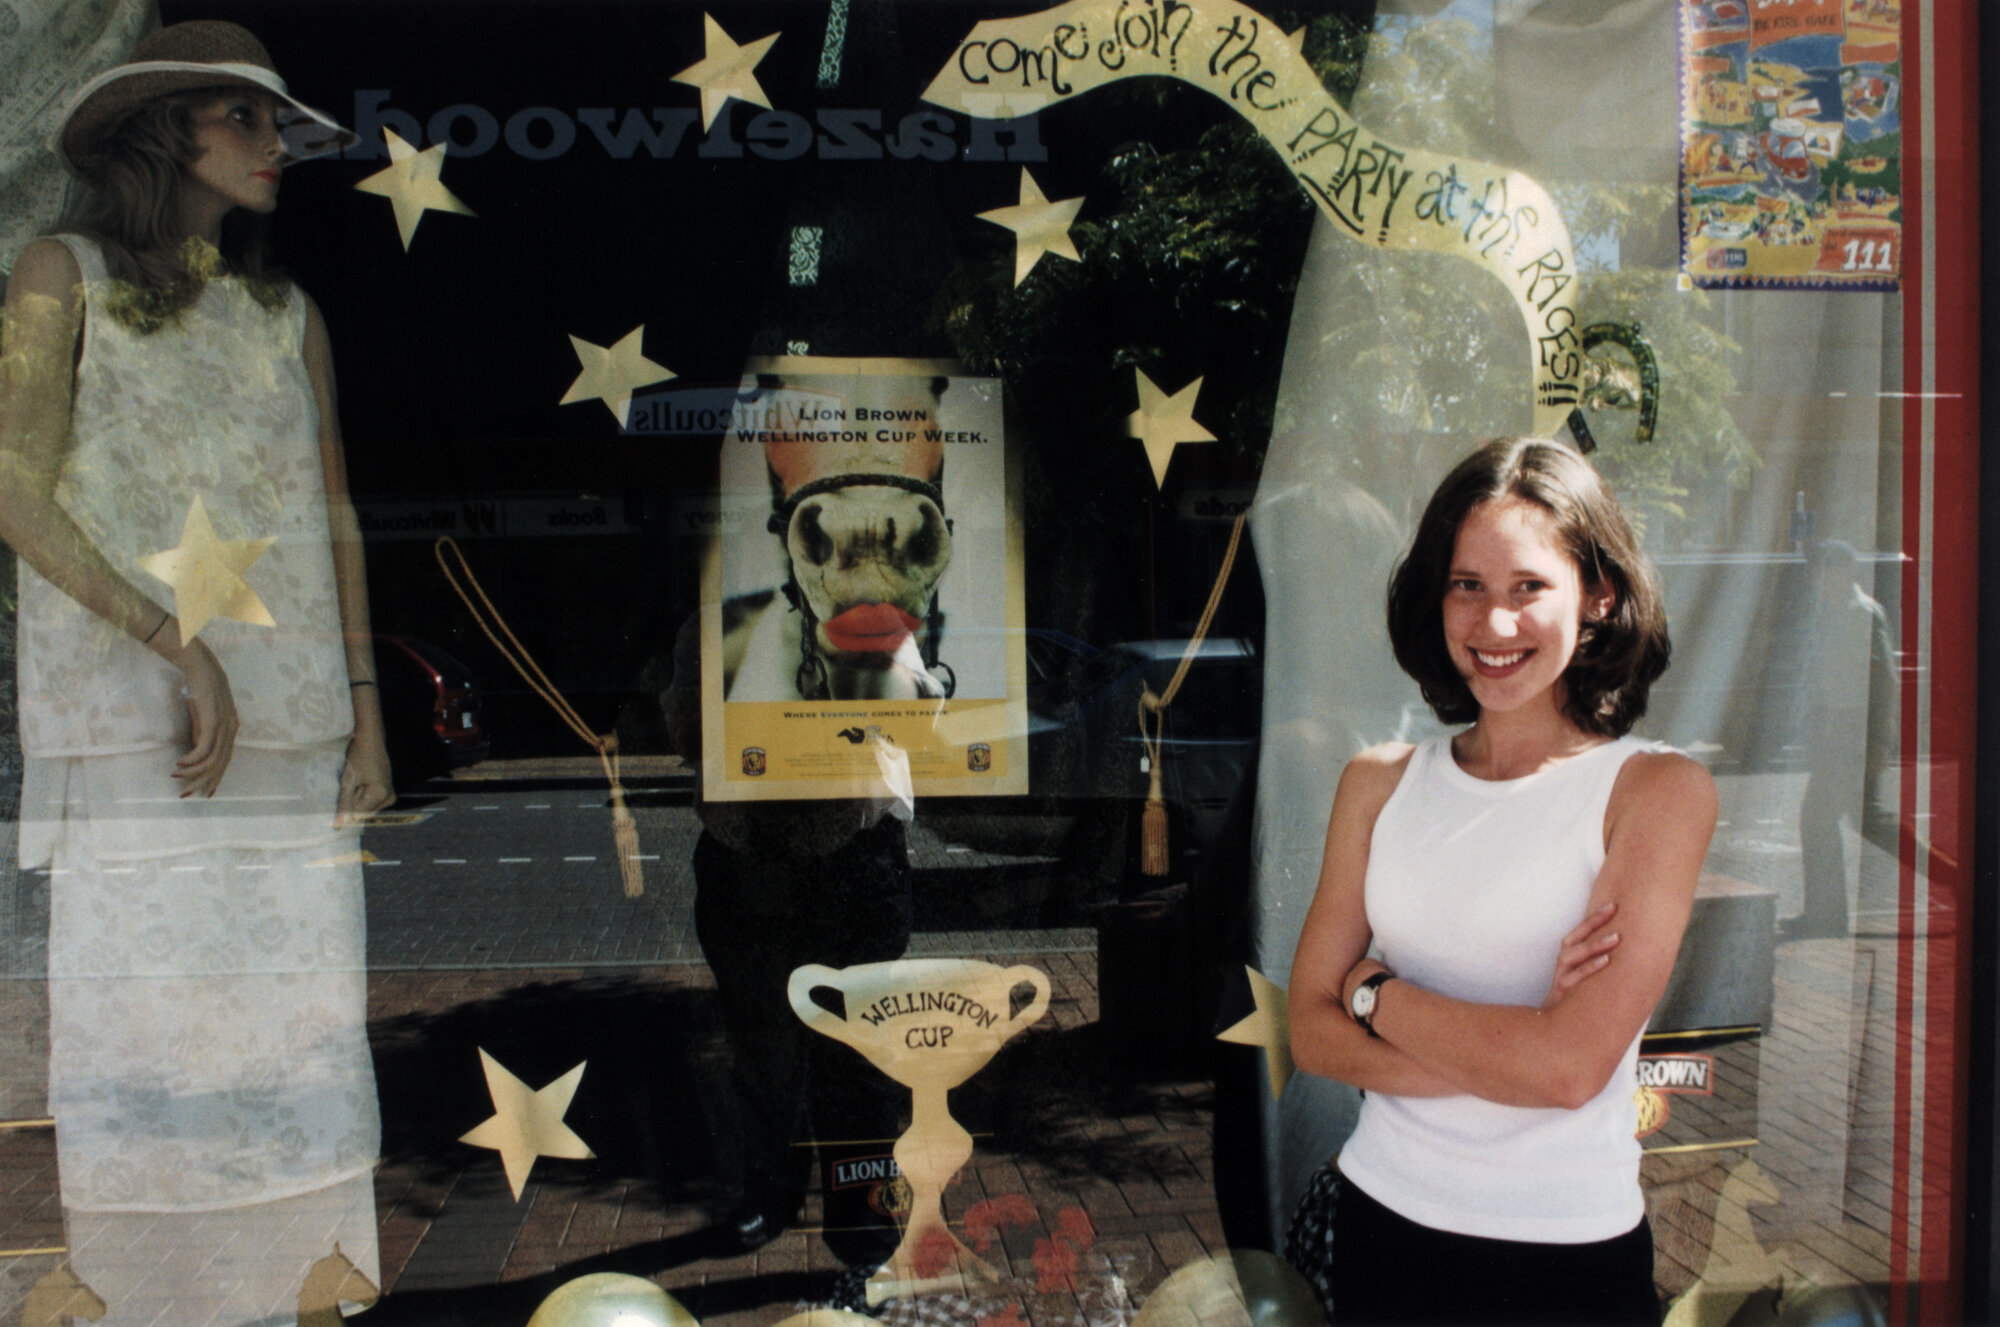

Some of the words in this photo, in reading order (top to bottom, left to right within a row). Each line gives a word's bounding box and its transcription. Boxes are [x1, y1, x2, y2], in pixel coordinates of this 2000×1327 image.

[1209, 16, 1297, 110] the
[1286, 107, 1414, 245] PARTY
[1416, 163, 1467, 226] at
[1842, 239, 1892, 272] 111
[799, 407, 847, 422] LION
[855, 407, 927, 422] BROWN
[737, 429, 868, 444] WELLINGTON
[876, 429, 917, 443] CUP
[924, 429, 989, 444] WEEK.
[783, 711, 817, 719] WHERE
[820, 711, 869, 719] EVERYONE
[905, 710, 917, 718] TO
[861, 991, 1000, 1029] WELLINGTON
[905, 1026, 954, 1050] CUP
[1638, 1060, 1708, 1087] ROWN
[837, 1159, 886, 1184] LION
